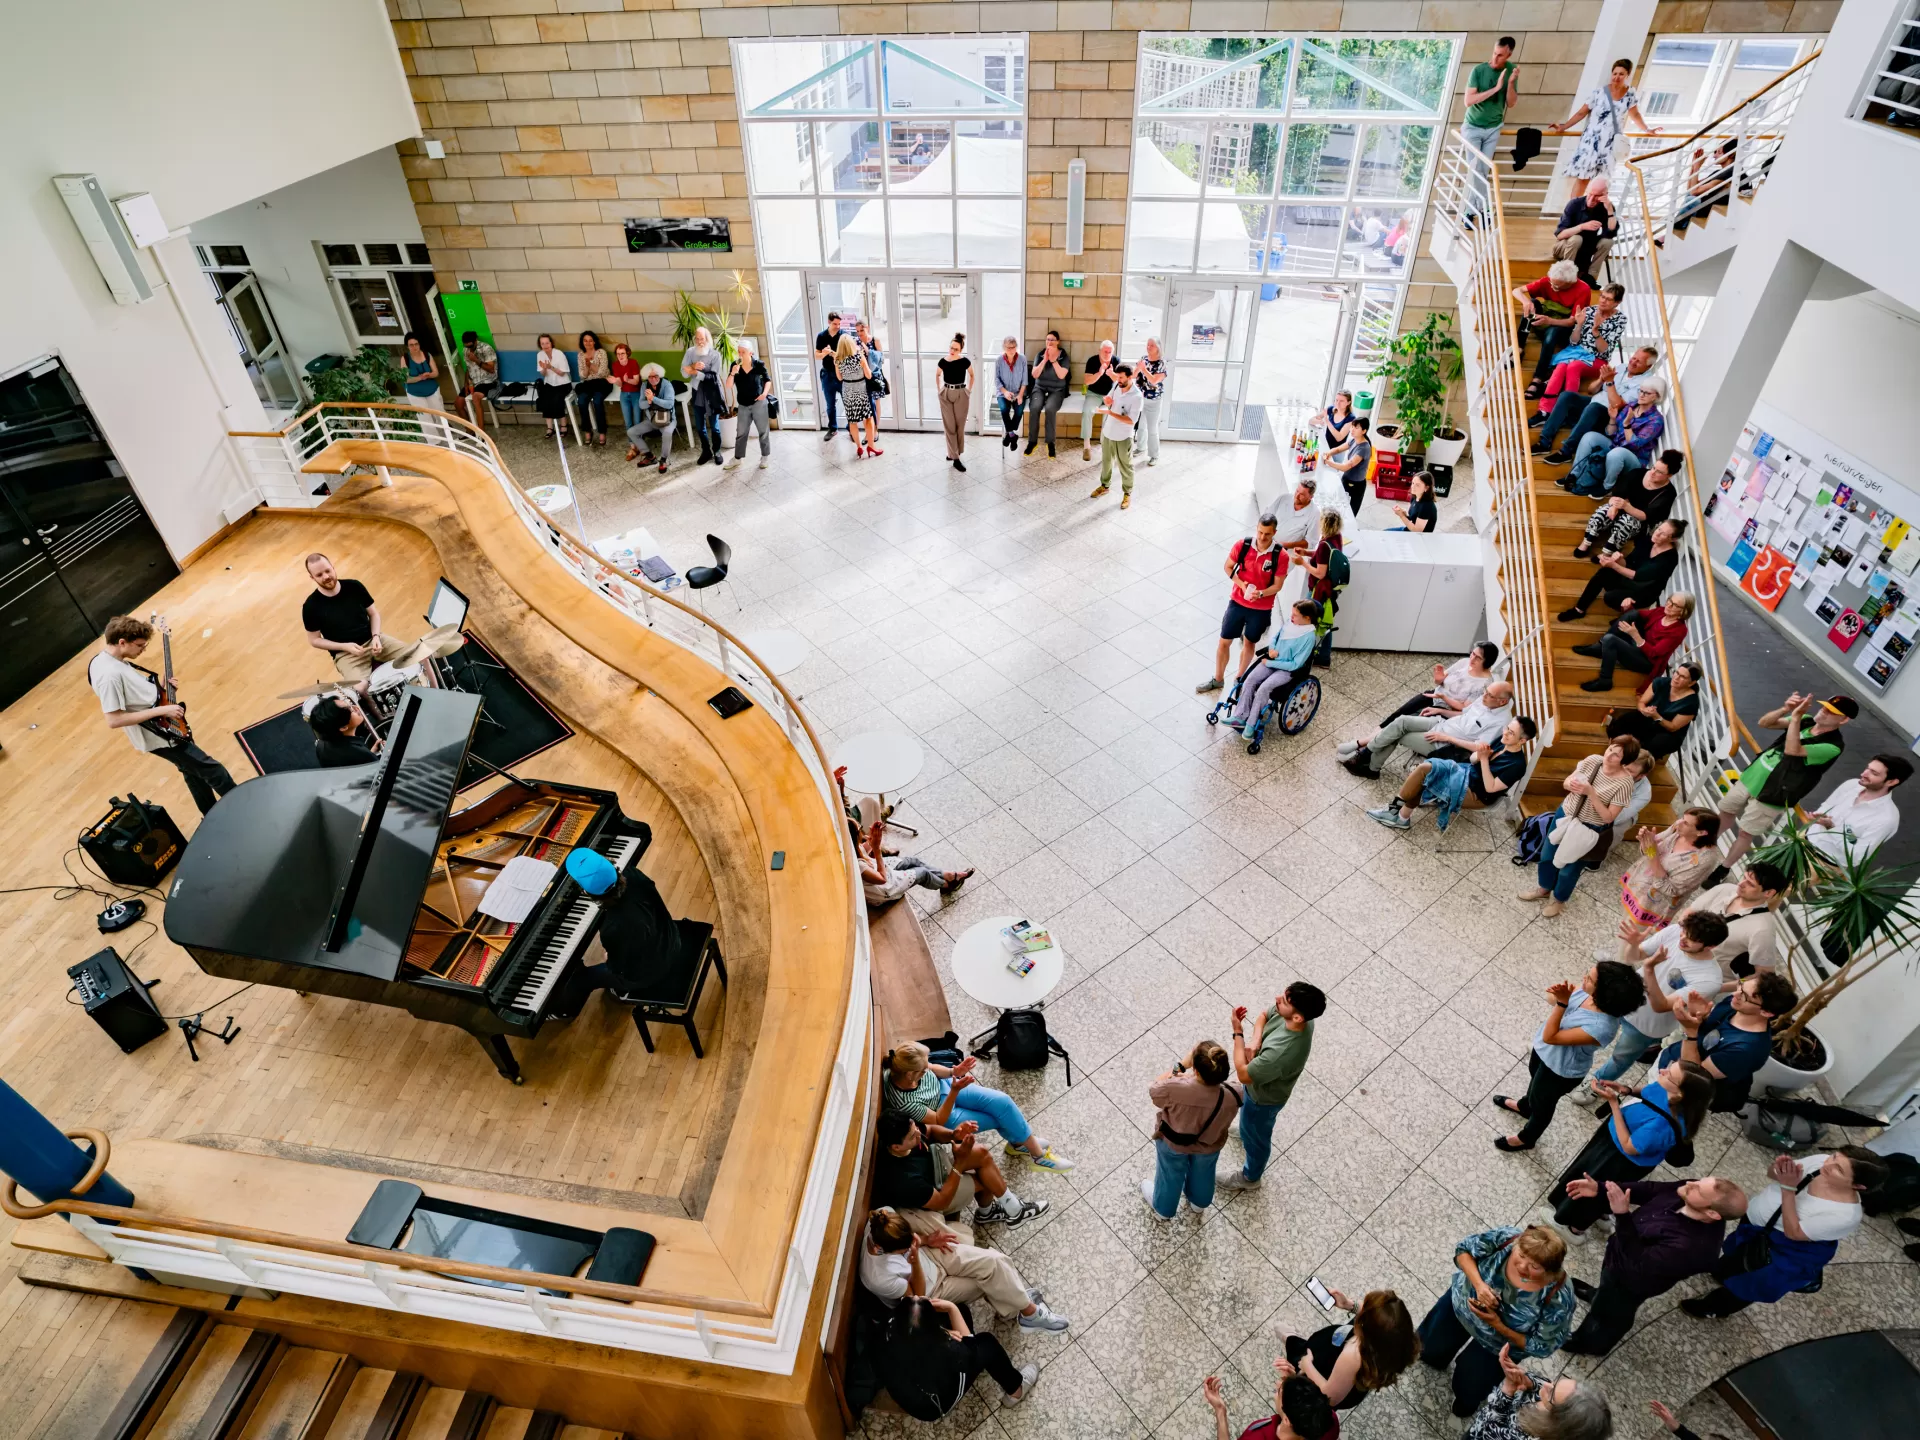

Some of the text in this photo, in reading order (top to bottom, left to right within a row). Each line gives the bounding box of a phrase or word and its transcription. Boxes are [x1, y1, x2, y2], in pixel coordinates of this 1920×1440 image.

[684, 240, 728, 249] Großer Saal
[448, 309, 456, 318] B
[1824, 452, 1883, 493] Kleinanzeigen
